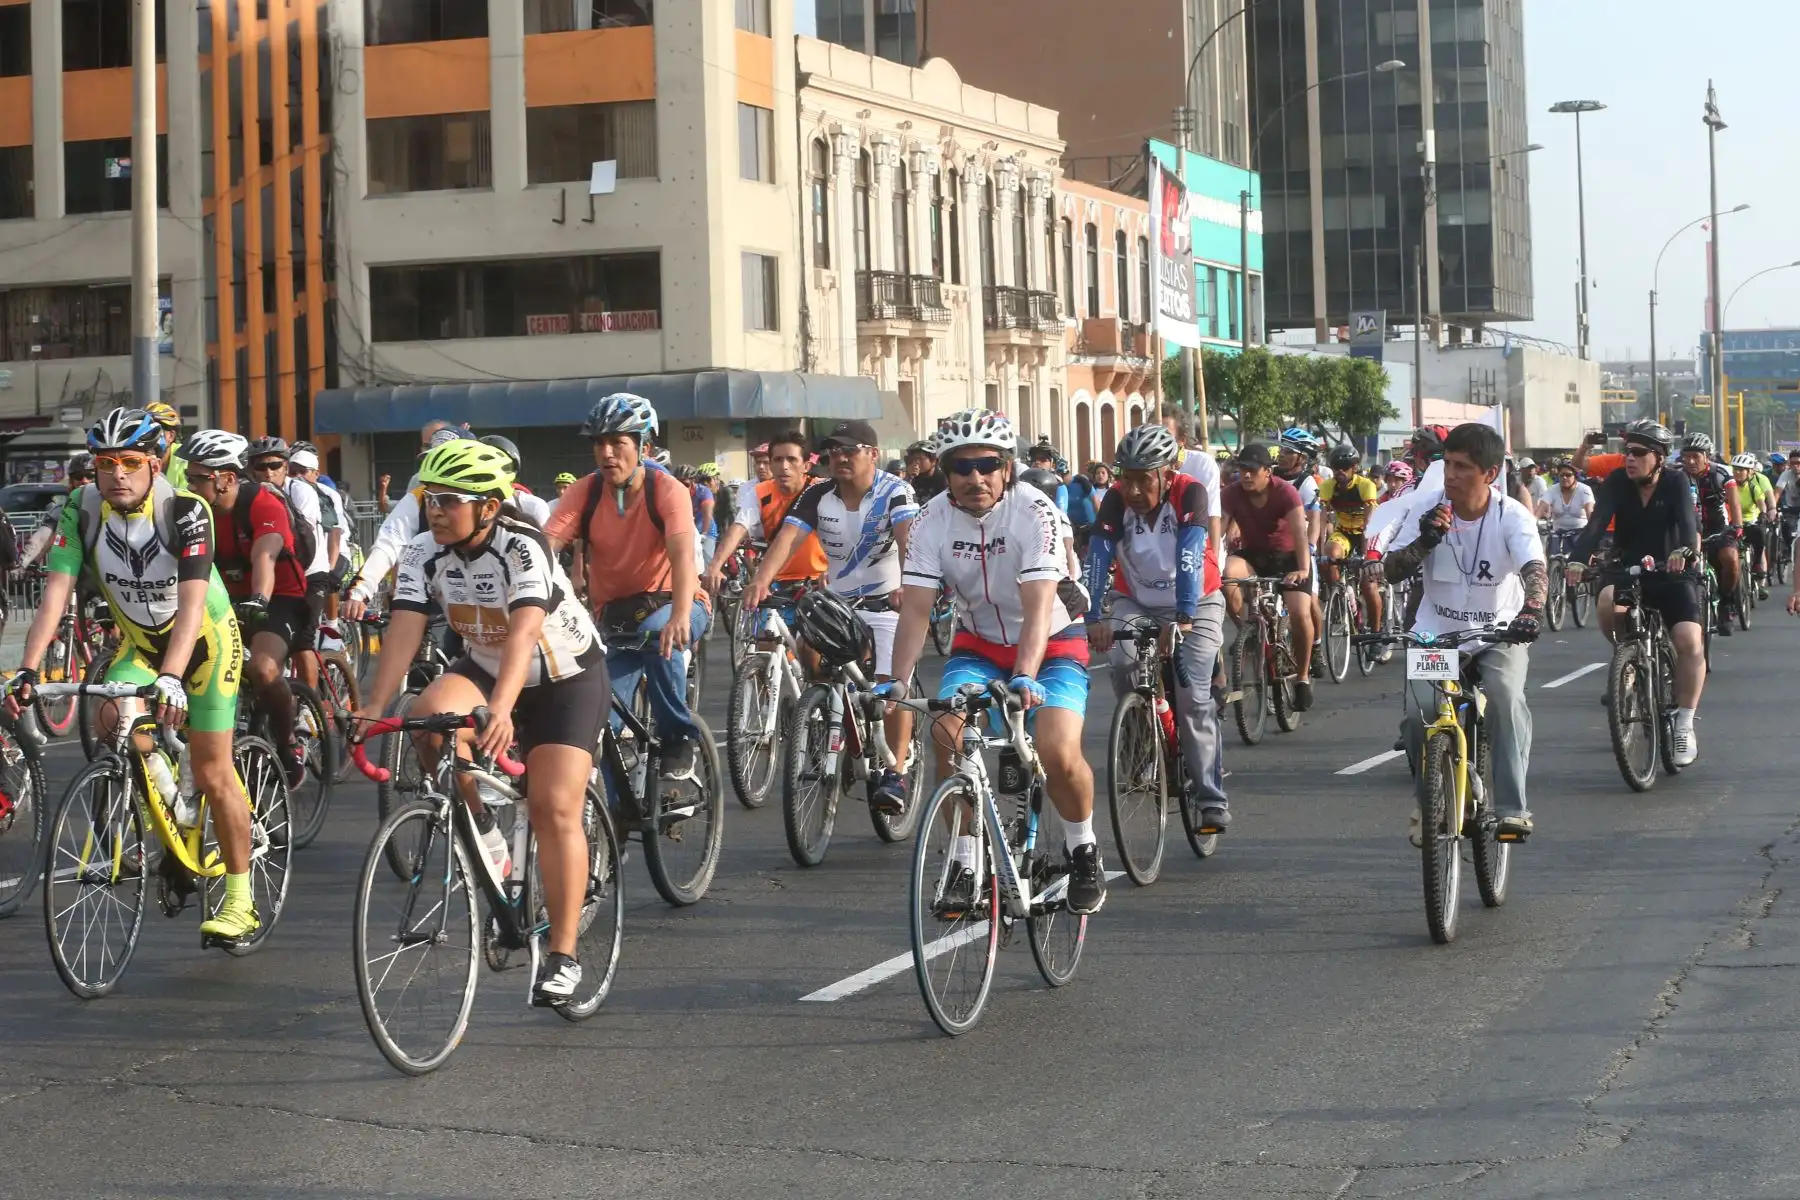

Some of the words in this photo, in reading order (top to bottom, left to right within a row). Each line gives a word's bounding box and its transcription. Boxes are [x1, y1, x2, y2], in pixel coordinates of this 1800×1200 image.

[529, 316, 568, 333] CENTRO
[1181, 547, 1193, 574] SAT
[105, 572, 177, 590] Pegaso
[223, 617, 241, 684] Pegaso
[1416, 662, 1449, 671] PLANETA
